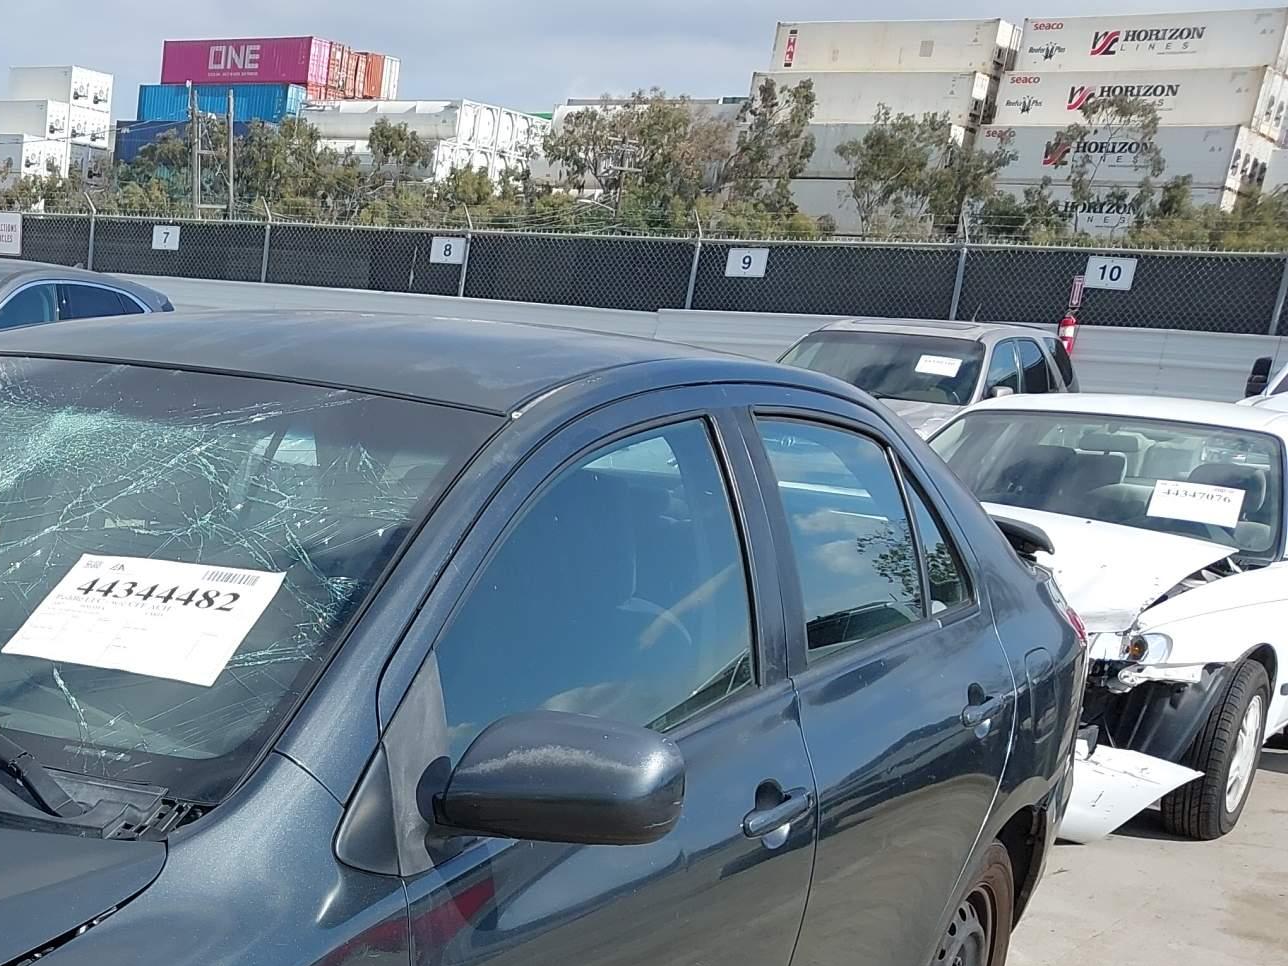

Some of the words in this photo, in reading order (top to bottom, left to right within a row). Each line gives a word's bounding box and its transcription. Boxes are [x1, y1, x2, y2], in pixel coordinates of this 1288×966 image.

[1033, 22, 1064, 31] seaco
[1123, 27, 1206, 42] HORIZON
[1120, 42, 1189, 52] LINES
[208, 45, 260, 69] ONE
[1010, 76, 1041, 84] seaco
[1098, 85, 1180, 98] HORIZON
[1074, 141, 1153, 154] HORIZON
[163, 231, 170, 244] 7
[443, 243, 453, 257] 8
[741, 255, 752, 270] 9
[1099, 264, 1122, 281] 10
[76, 577, 241, 612] 44344482
